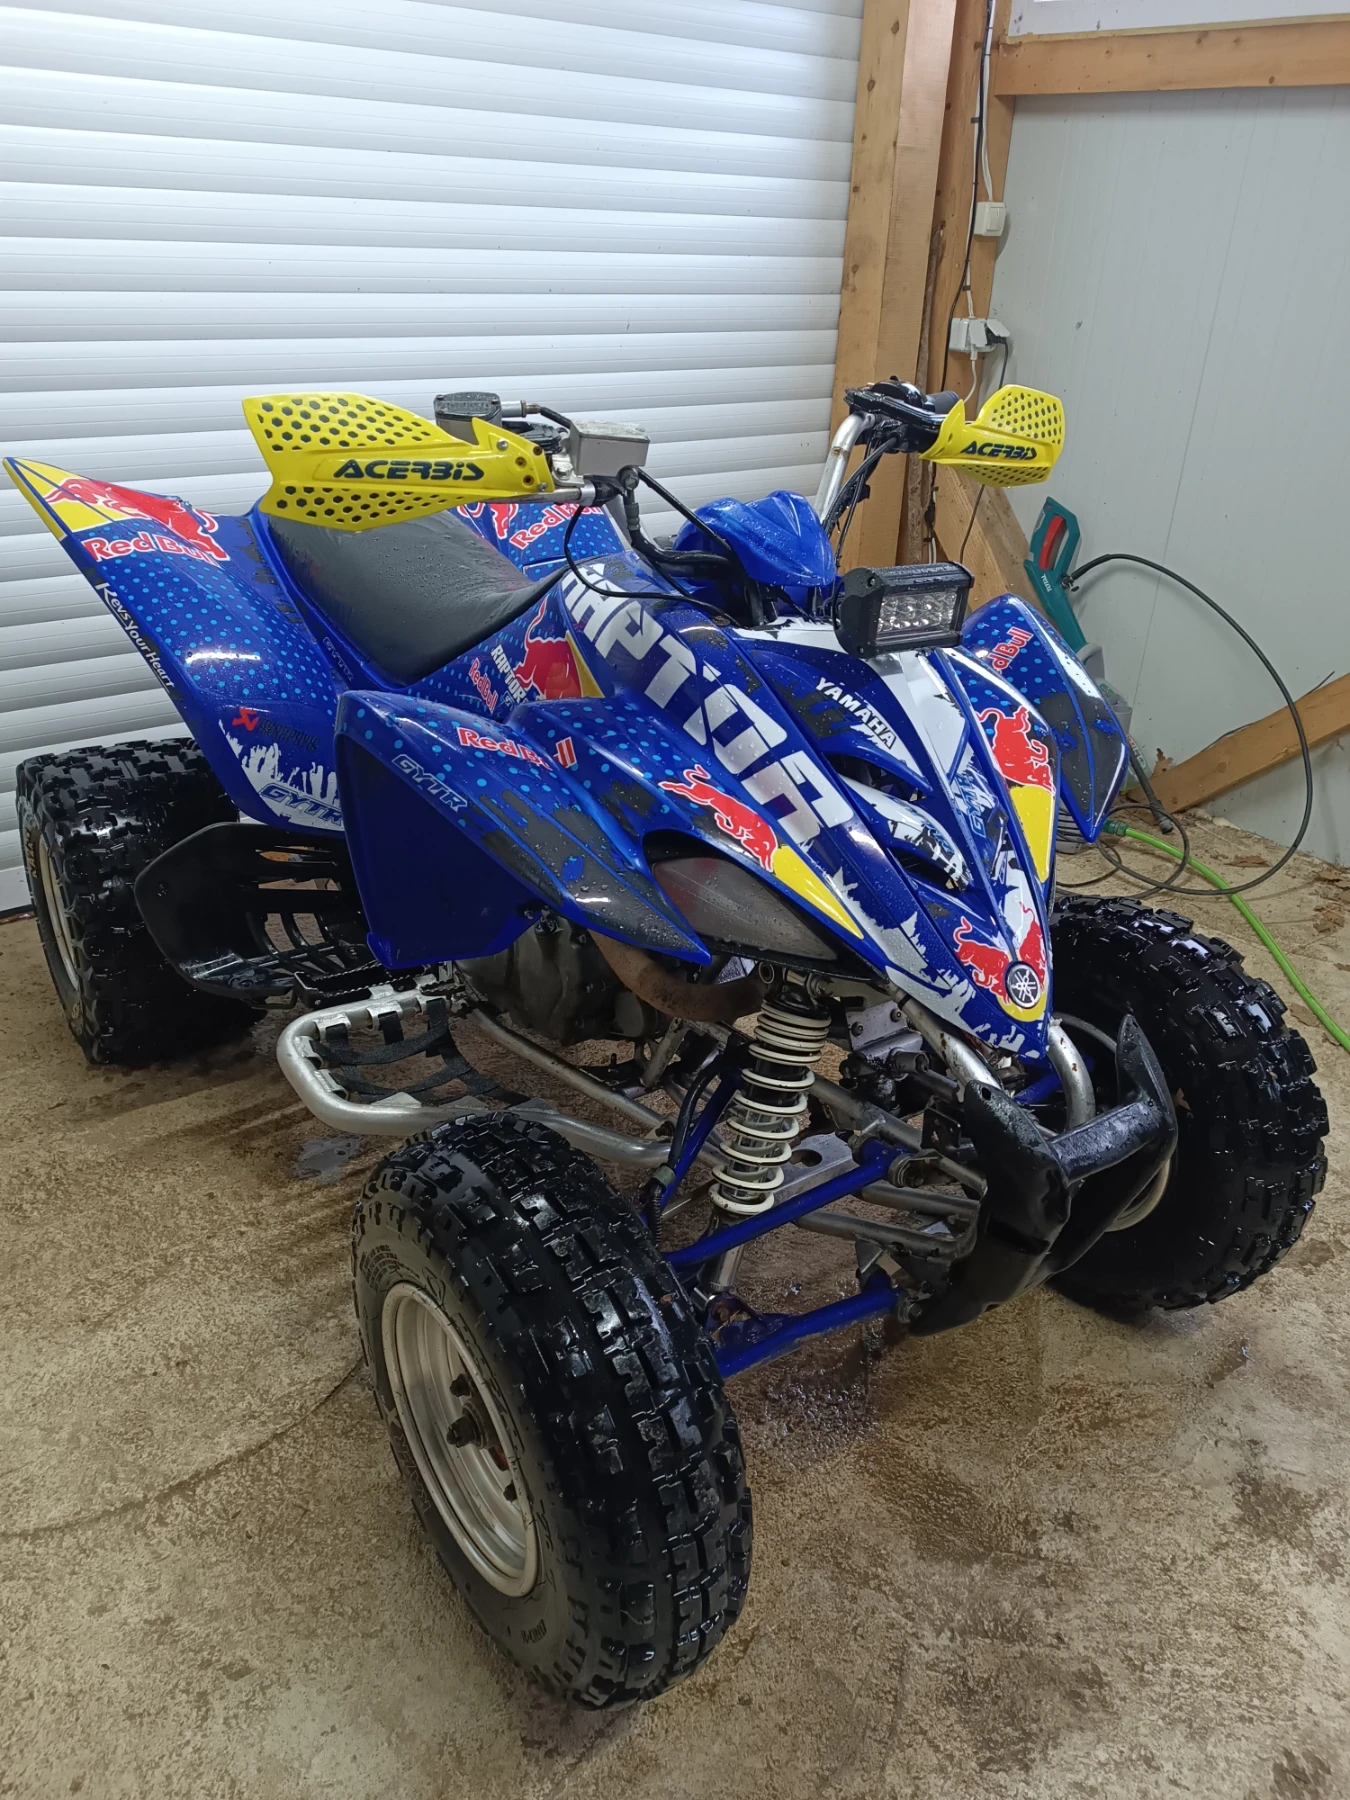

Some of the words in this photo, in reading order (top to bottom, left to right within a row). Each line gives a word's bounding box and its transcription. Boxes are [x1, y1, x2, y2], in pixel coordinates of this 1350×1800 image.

[962, 440, 1038, 461] ACERBIS
[333, 458, 485, 481] ACERBIS
[81, 531, 157, 562] Red
[146, 651, 175, 688] Heart
[491, 644, 527, 704] RAPTOR
[816, 677, 897, 750] YAMAHA
[391, 754, 468, 812] GYTR
